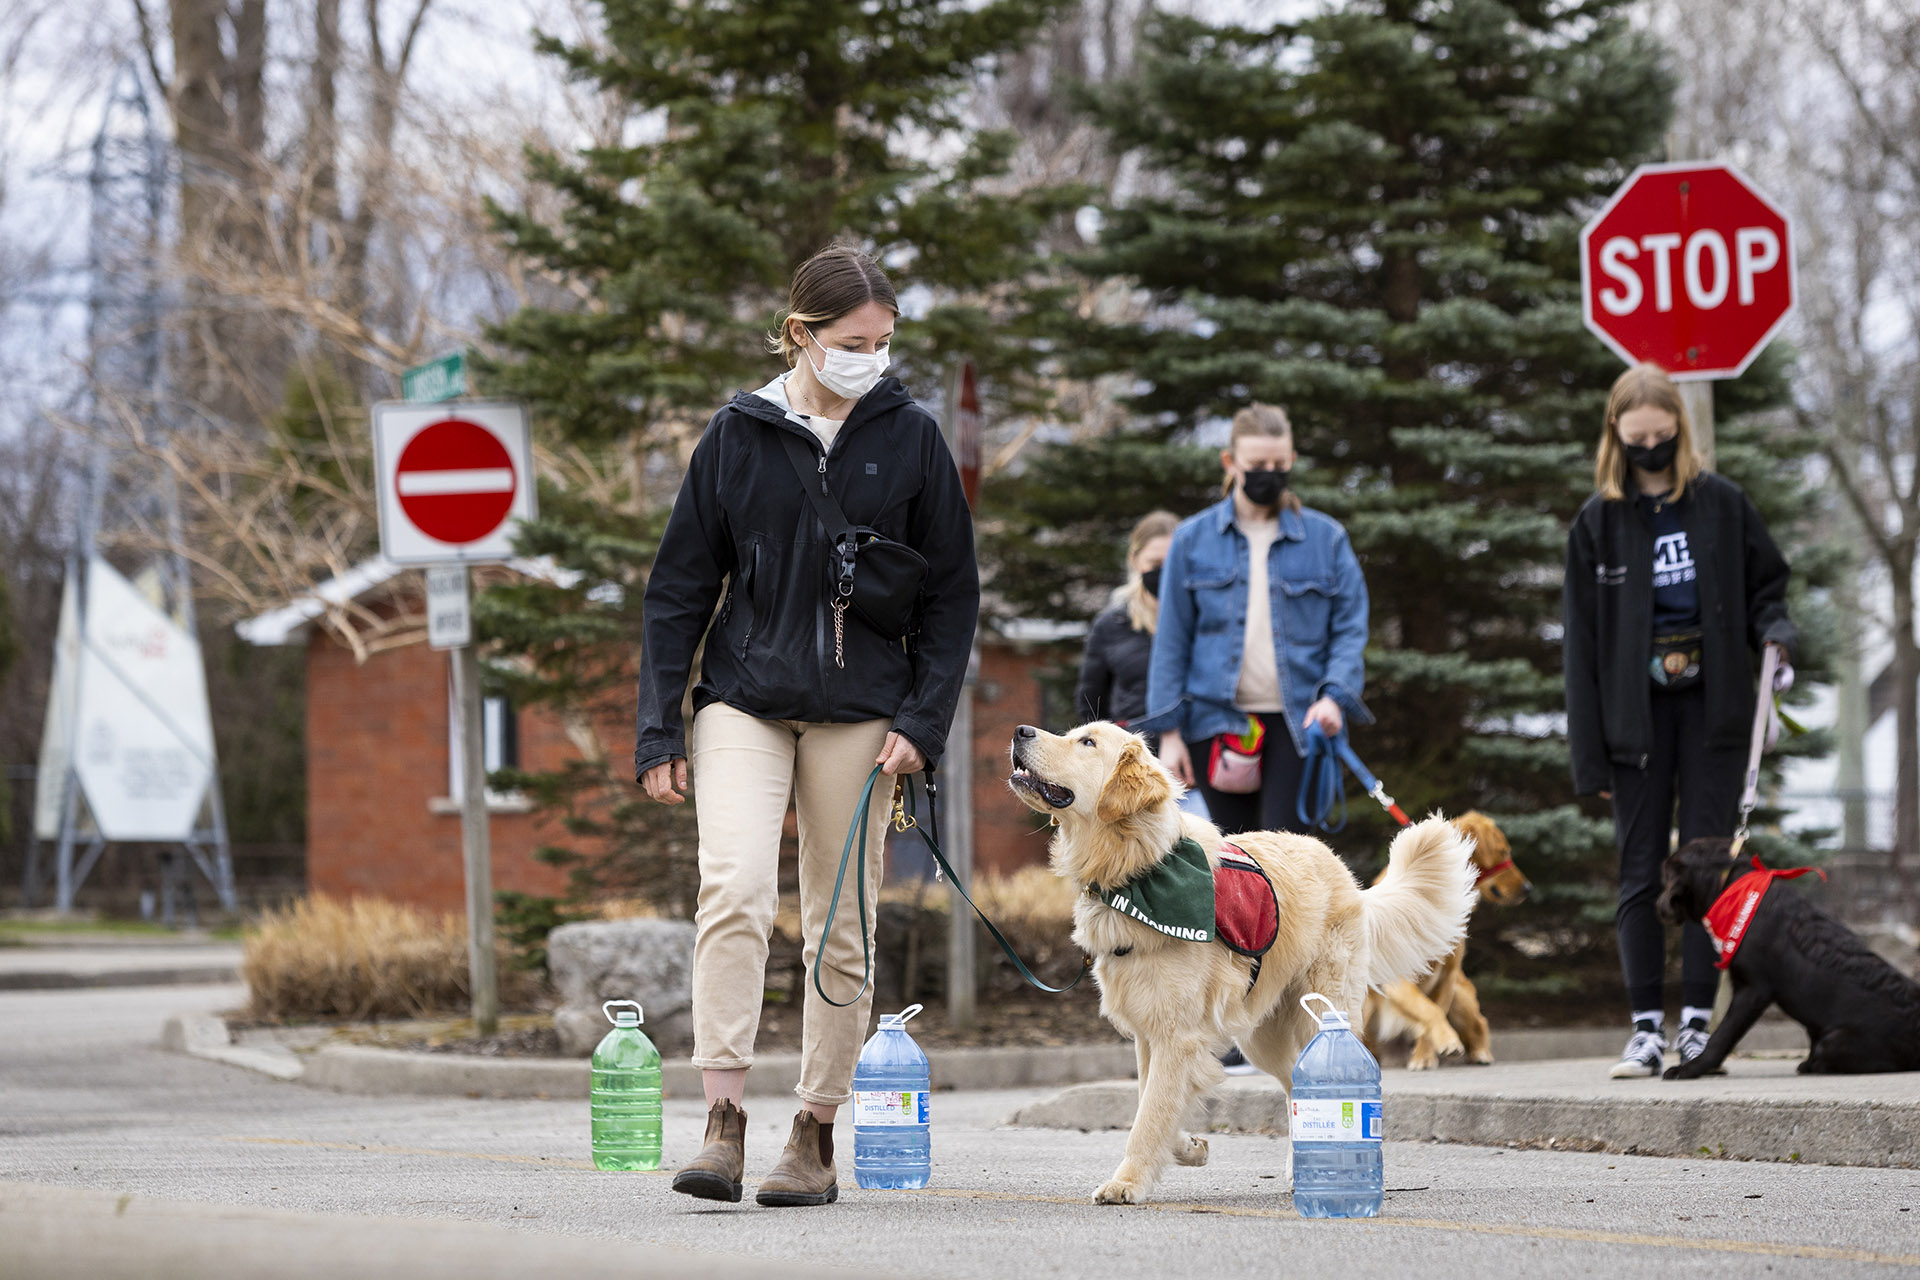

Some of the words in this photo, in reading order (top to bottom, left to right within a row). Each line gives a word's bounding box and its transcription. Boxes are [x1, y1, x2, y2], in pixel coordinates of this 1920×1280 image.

[1599, 226, 1780, 316] STOP
[1111, 894, 1129, 912] IN
[1729, 890, 1760, 939] TRAINING
[1302, 1120, 1335, 1128] DISTILLÉE
